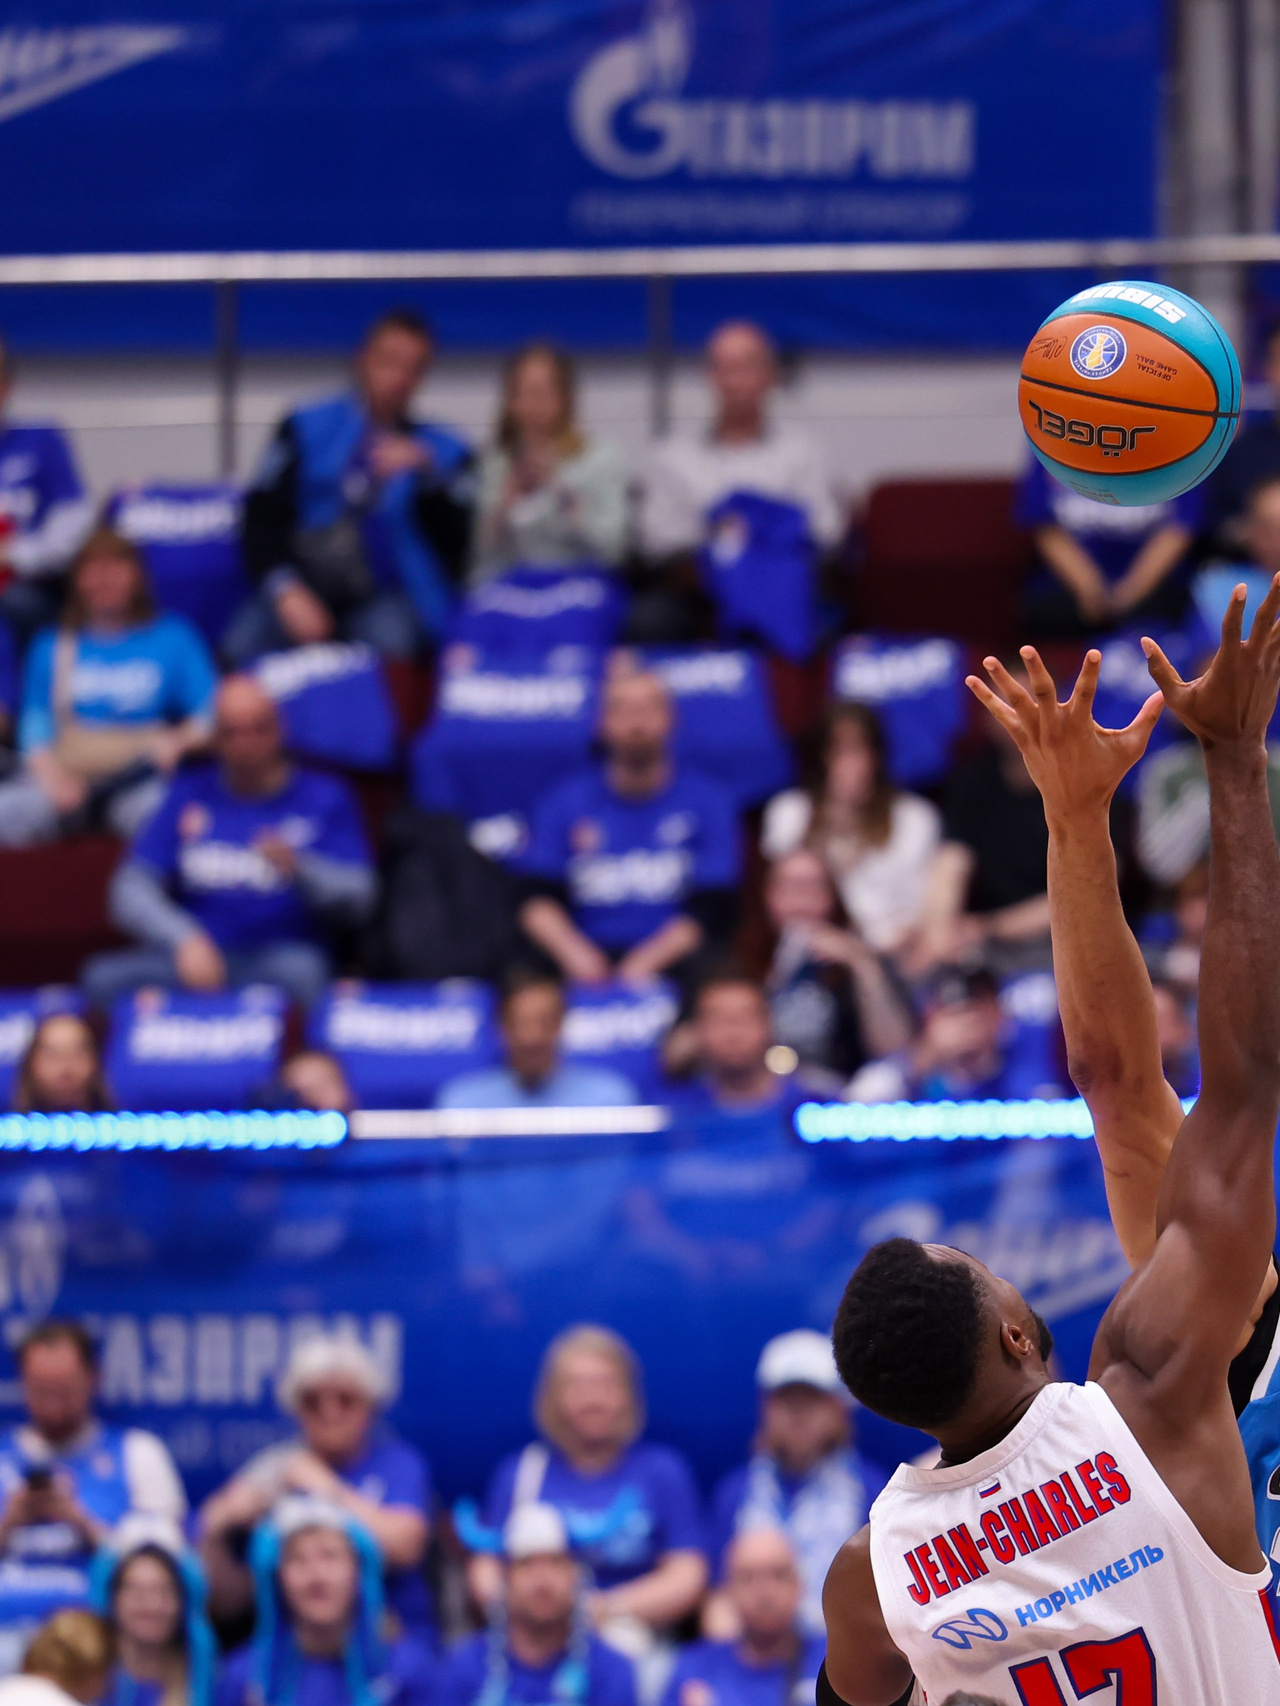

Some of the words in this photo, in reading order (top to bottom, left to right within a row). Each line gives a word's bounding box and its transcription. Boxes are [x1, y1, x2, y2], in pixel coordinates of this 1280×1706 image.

[1135, 354, 1155, 366] BALL
[1156, 362, 1178, 375] GAME
[1137, 363, 1172, 381] OFFICIAL
[903, 1451, 1132, 1606] JEAN-CHARLES
[1014, 1544, 1165, 1627] НОРНИКЕЛЬ
